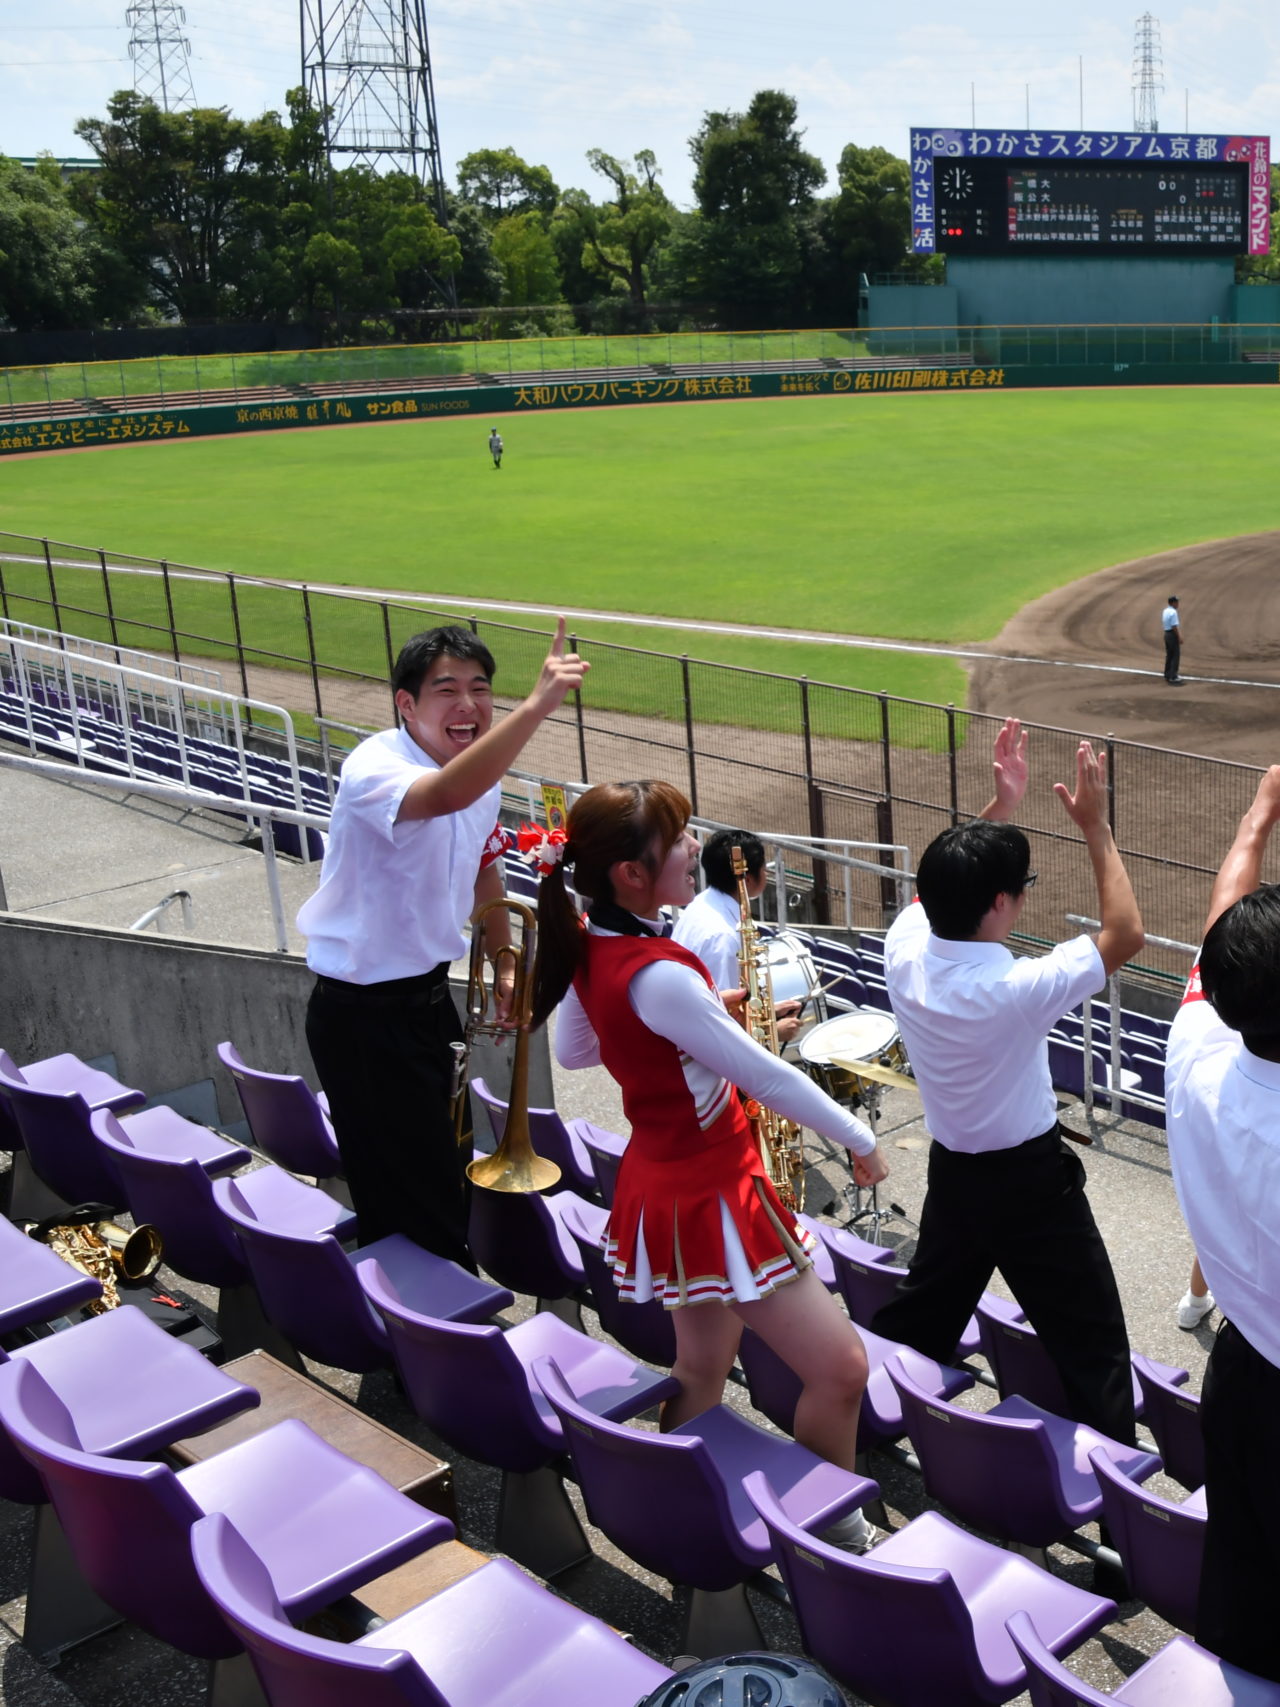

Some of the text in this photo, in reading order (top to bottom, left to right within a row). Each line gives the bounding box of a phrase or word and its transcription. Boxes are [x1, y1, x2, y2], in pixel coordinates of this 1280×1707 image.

[967, 132, 1218, 160] わかさスタジアム京都
[912, 132, 934, 248] わかさ生活
[1014, 179, 1051, 189] 一橋大
[1158, 180, 1176, 190] 0 0
[1014, 192, 1051, 202] 阪公大
[1179, 194, 1186, 204] 0
[1251, 141, 1268, 250] 花鈴のマウンド
[854, 368, 1005, 390] 佐川印刷株式会社
[513, 376, 753, 406] 大和ハウスパーキング株式会社
[366, 400, 418, 416] サン食品
[421, 400, 470, 412] SUN FOODS
